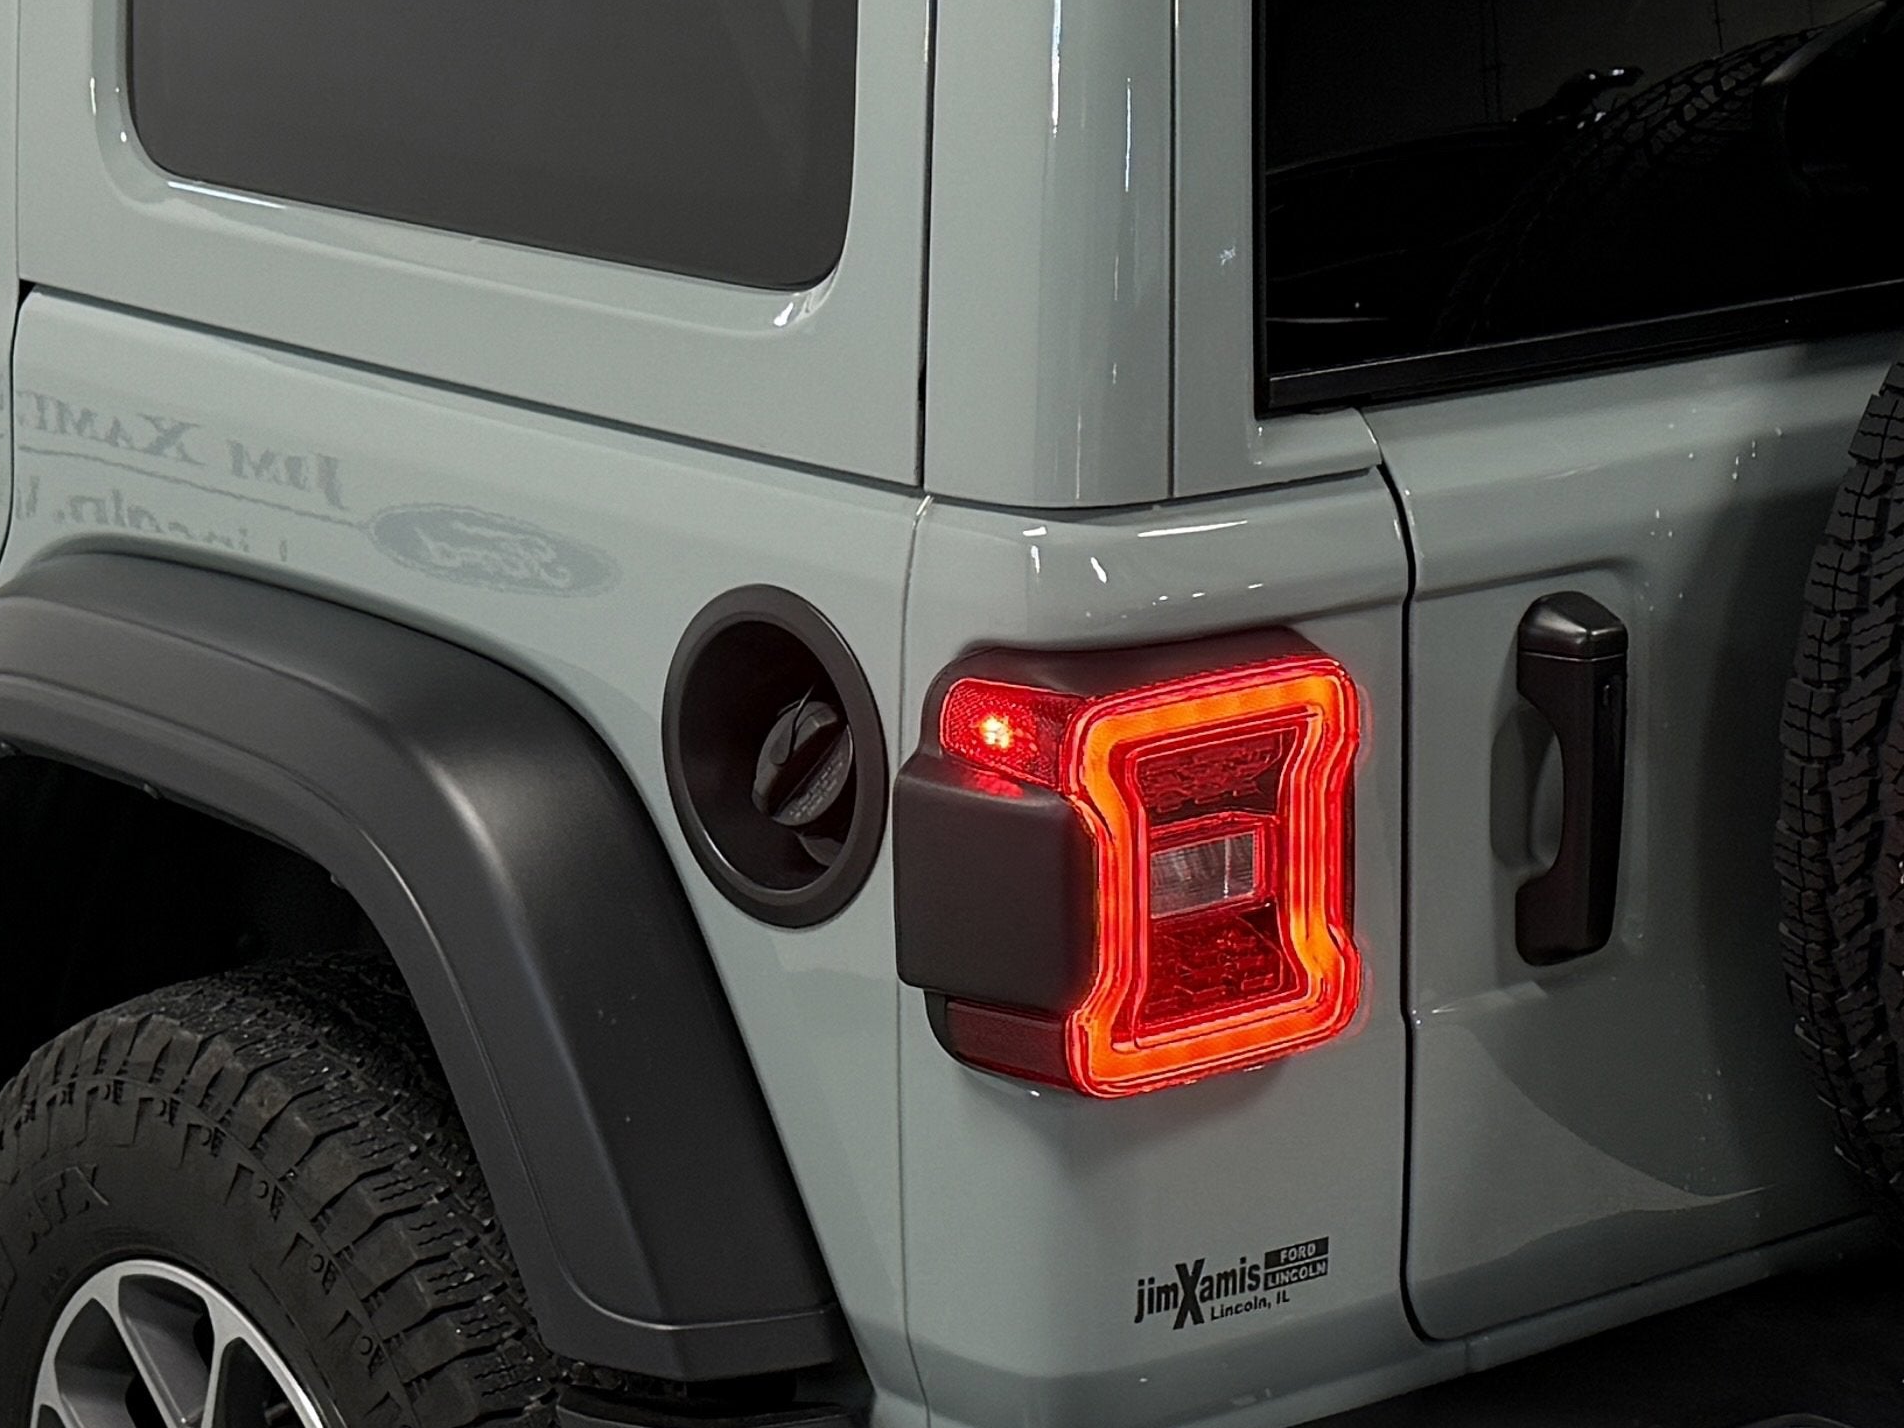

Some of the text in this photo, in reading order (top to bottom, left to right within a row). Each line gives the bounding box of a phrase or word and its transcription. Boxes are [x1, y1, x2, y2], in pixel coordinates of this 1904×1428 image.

[1280, 1243, 1317, 1264] FORD
[1267, 1261, 1327, 1287] LINCOLN
[1134, 1257, 1261, 1330] jimXamis
[1210, 1289, 1290, 1321] Lincoln, IL
